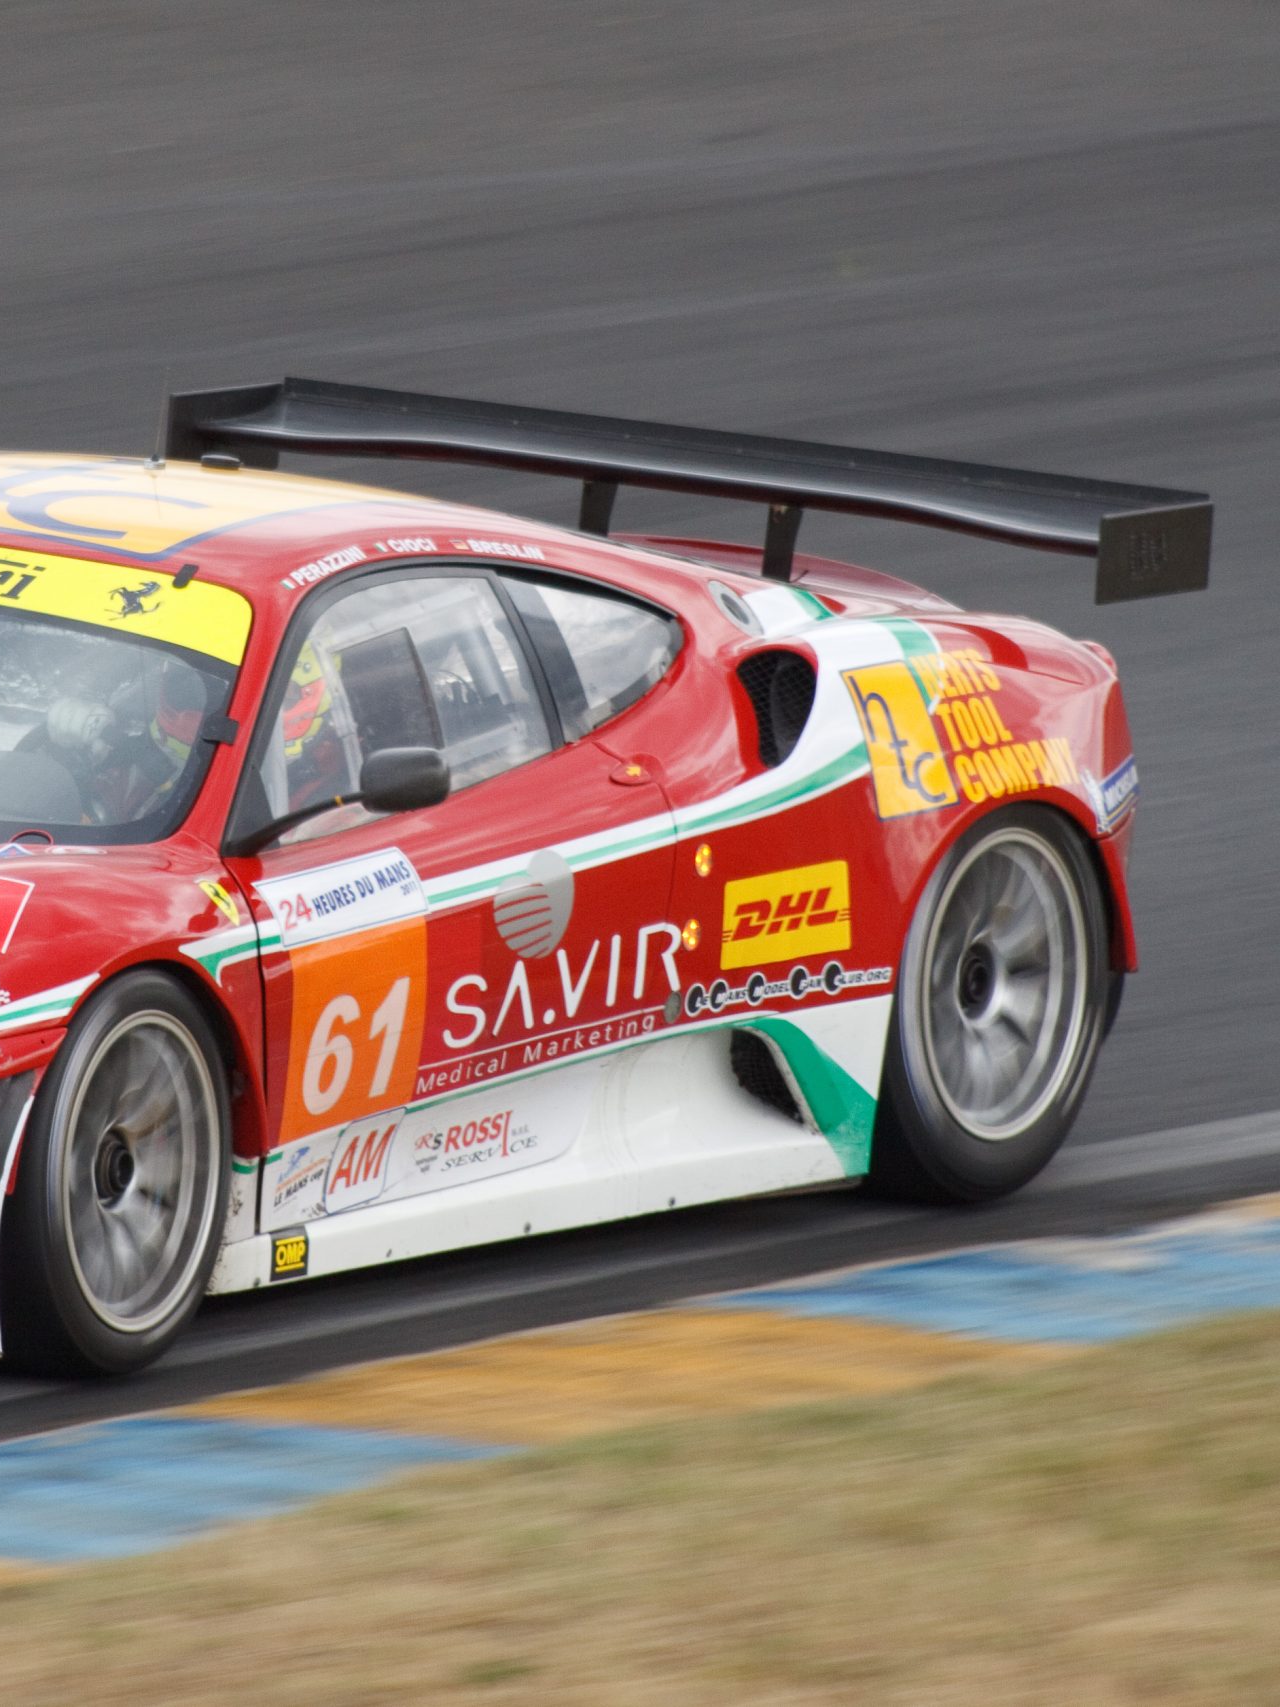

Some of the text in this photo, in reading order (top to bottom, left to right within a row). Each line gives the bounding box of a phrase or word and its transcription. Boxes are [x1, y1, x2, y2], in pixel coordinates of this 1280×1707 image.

[289, 545, 367, 587] PERAZZINI
[387, 538, 438, 554] CIOCI
[467, 540, 545, 560] BRESLIN
[908, 649, 1002, 699] HERTS
[935, 695, 1012, 752] TOOL
[953, 737, 1081, 803] COMPANY
[279, 861, 411, 930] 24 HEURES DU MANS
[732, 886, 839, 941] DHL
[302, 976, 410, 1116] 61
[416, 1012, 656, 1094] Medical Marketing
[328, 1123, 398, 1195] AM
[444, 1109, 513, 1157] ROSSI
[284, 1175, 308, 1199] MANS
[275, 1243, 306, 1267] OMP
